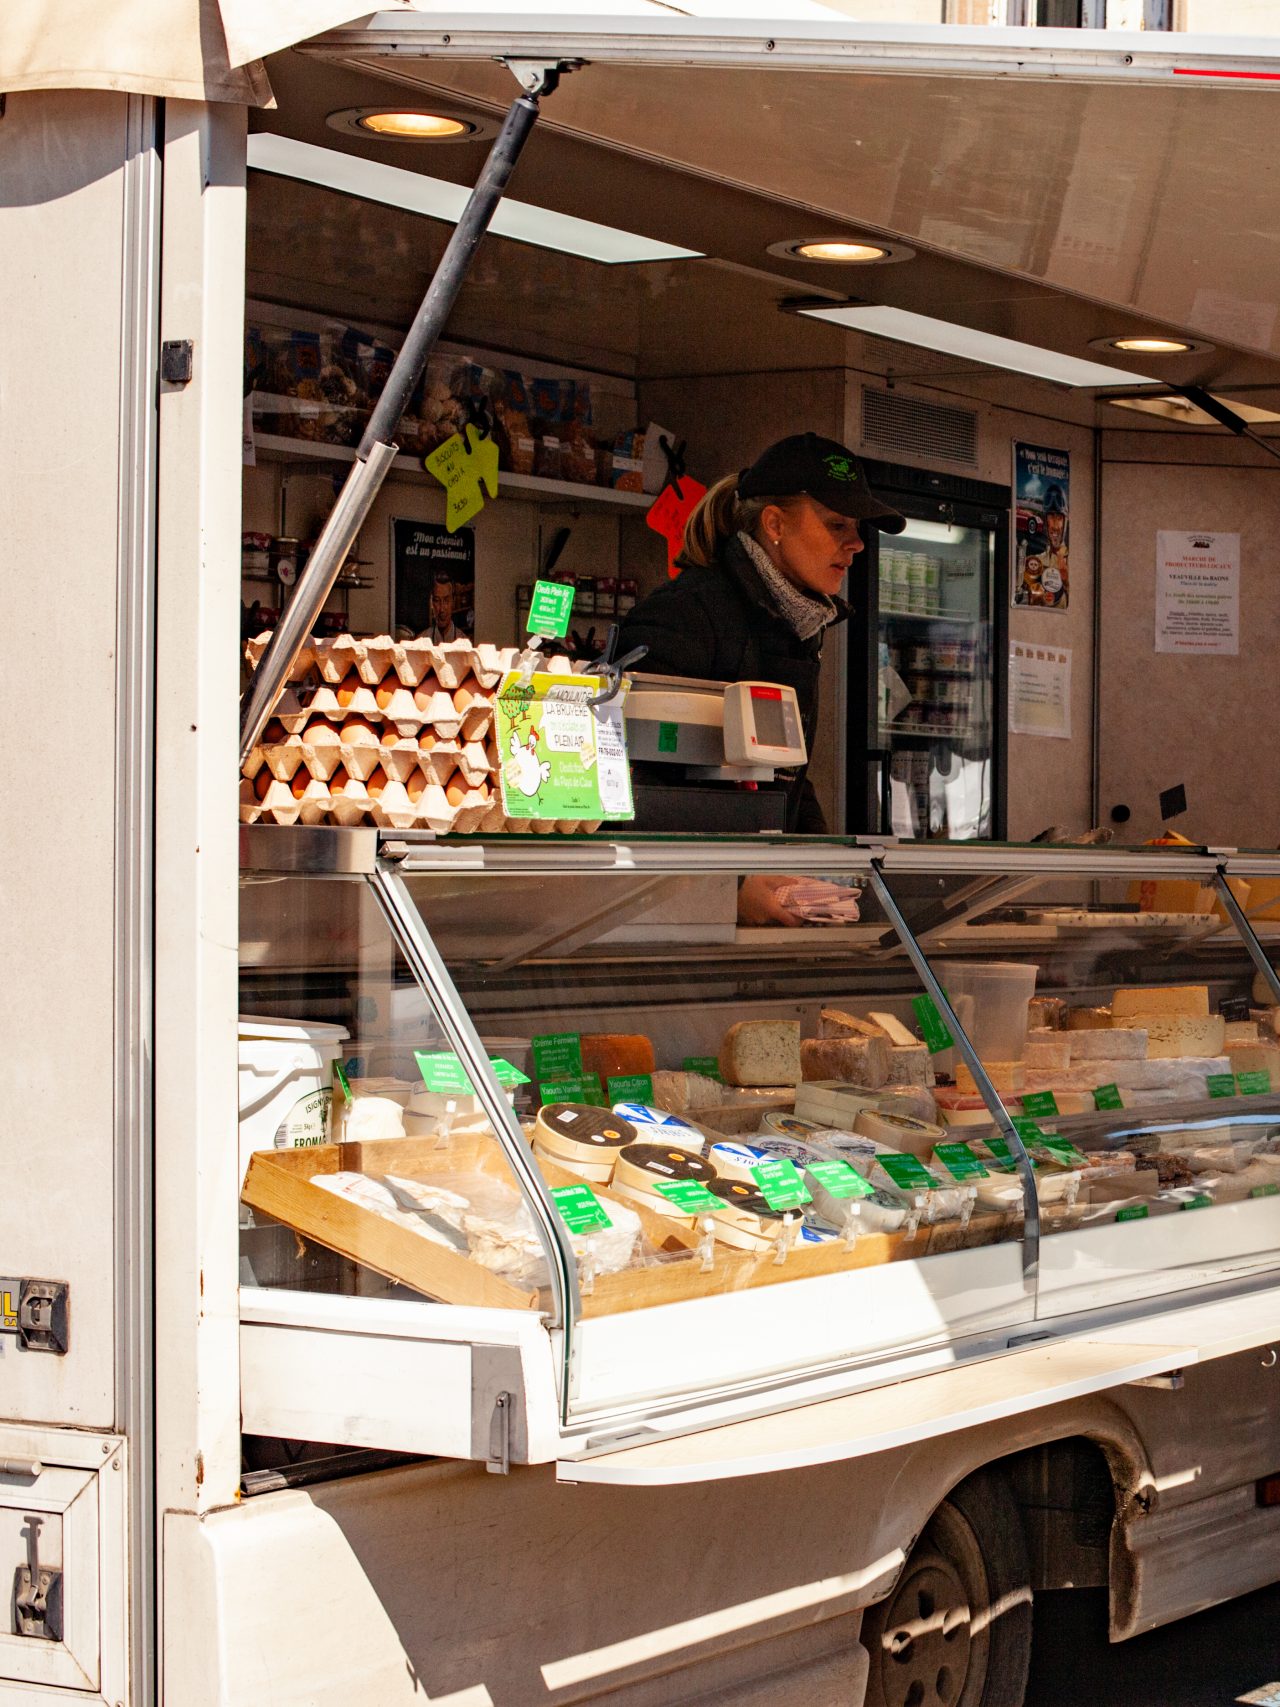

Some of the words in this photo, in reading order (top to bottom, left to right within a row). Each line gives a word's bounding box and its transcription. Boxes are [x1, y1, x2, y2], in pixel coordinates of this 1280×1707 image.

[413, 532, 434, 544] Mon
[405, 543, 418, 556] est
[419, 546, 430, 556] un
[554, 734, 574, 746] PLEIN
[533, 1039, 552, 1047] Crème
